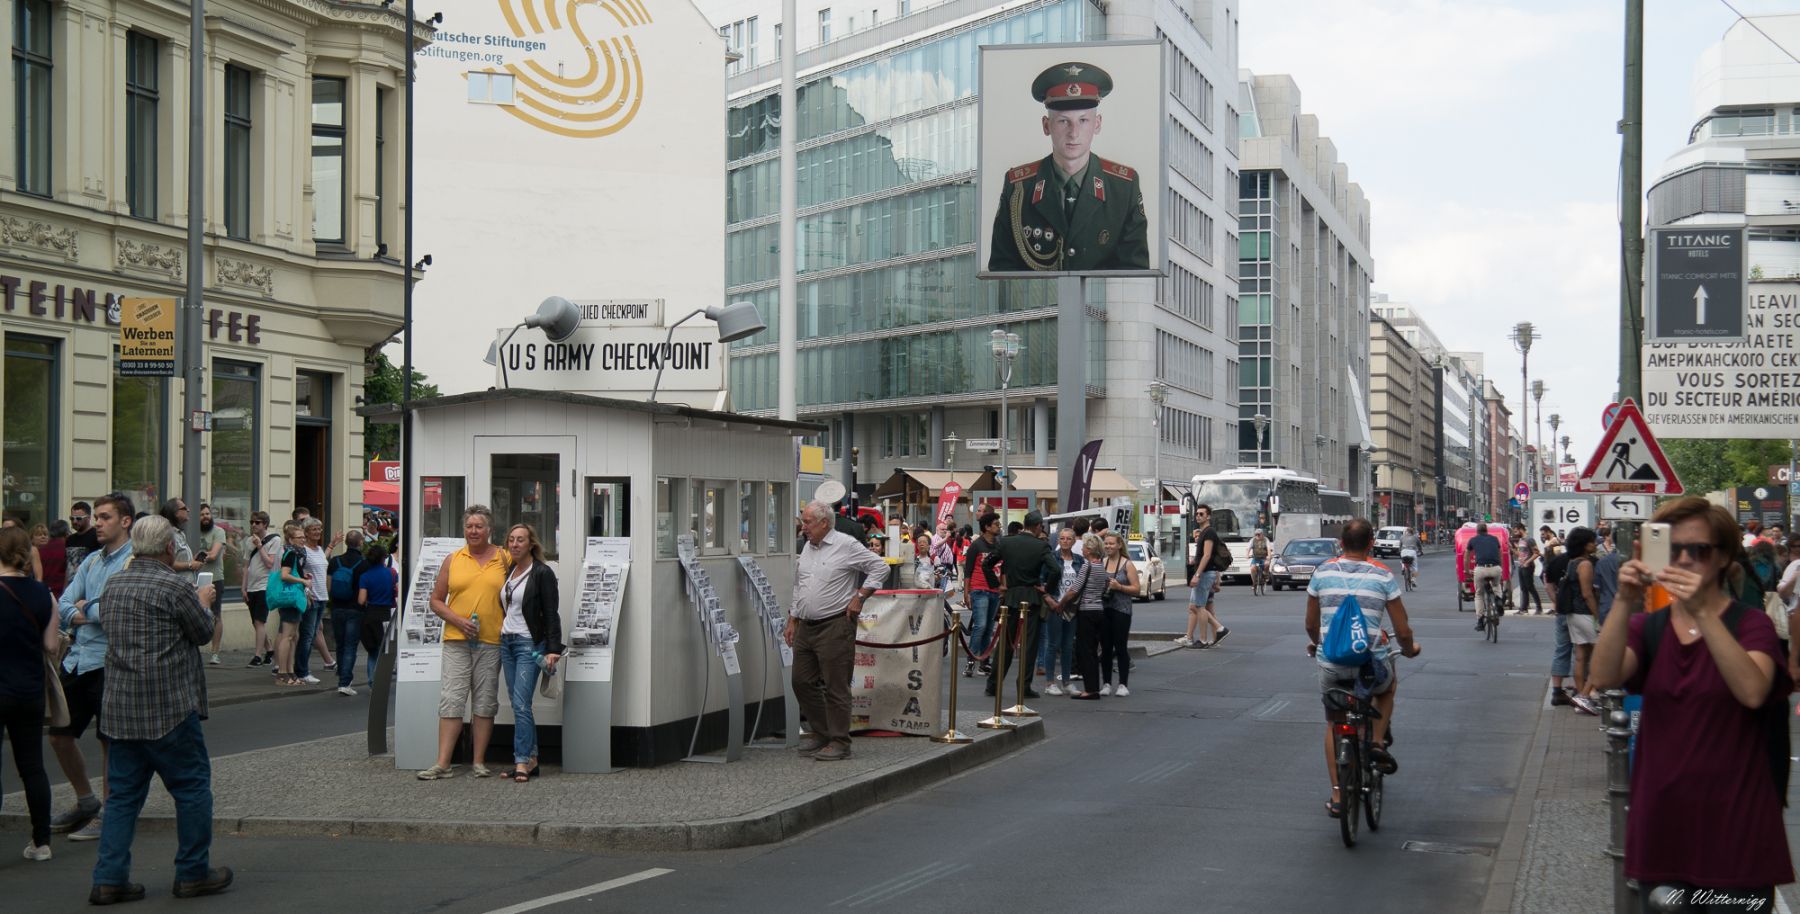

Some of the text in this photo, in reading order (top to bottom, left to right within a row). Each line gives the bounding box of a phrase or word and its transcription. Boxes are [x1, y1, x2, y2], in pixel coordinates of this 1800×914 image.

[484, 34, 546, 52] Stiftungen
[1667, 234, 1731, 246] TITANIC
[1688, 250, 1709, 258] HOTELS
[602, 303, 648, 319] CHECKPOINT
[123, 327, 174, 340] Werben
[122, 346, 174, 356] Laternen!
[509, 342, 712, 371] U S ARMY CHECKPOINT
[1677, 372, 1724, 387] VOUS
[1648, 392, 1668, 406] DU
[1674, 391, 1742, 407] SECTEUR
[1709, 414, 1725, 424] DEN
[1728, 414, 1799, 424] AMERIKANISCHEN
[891, 718, 930, 730] STAMP
